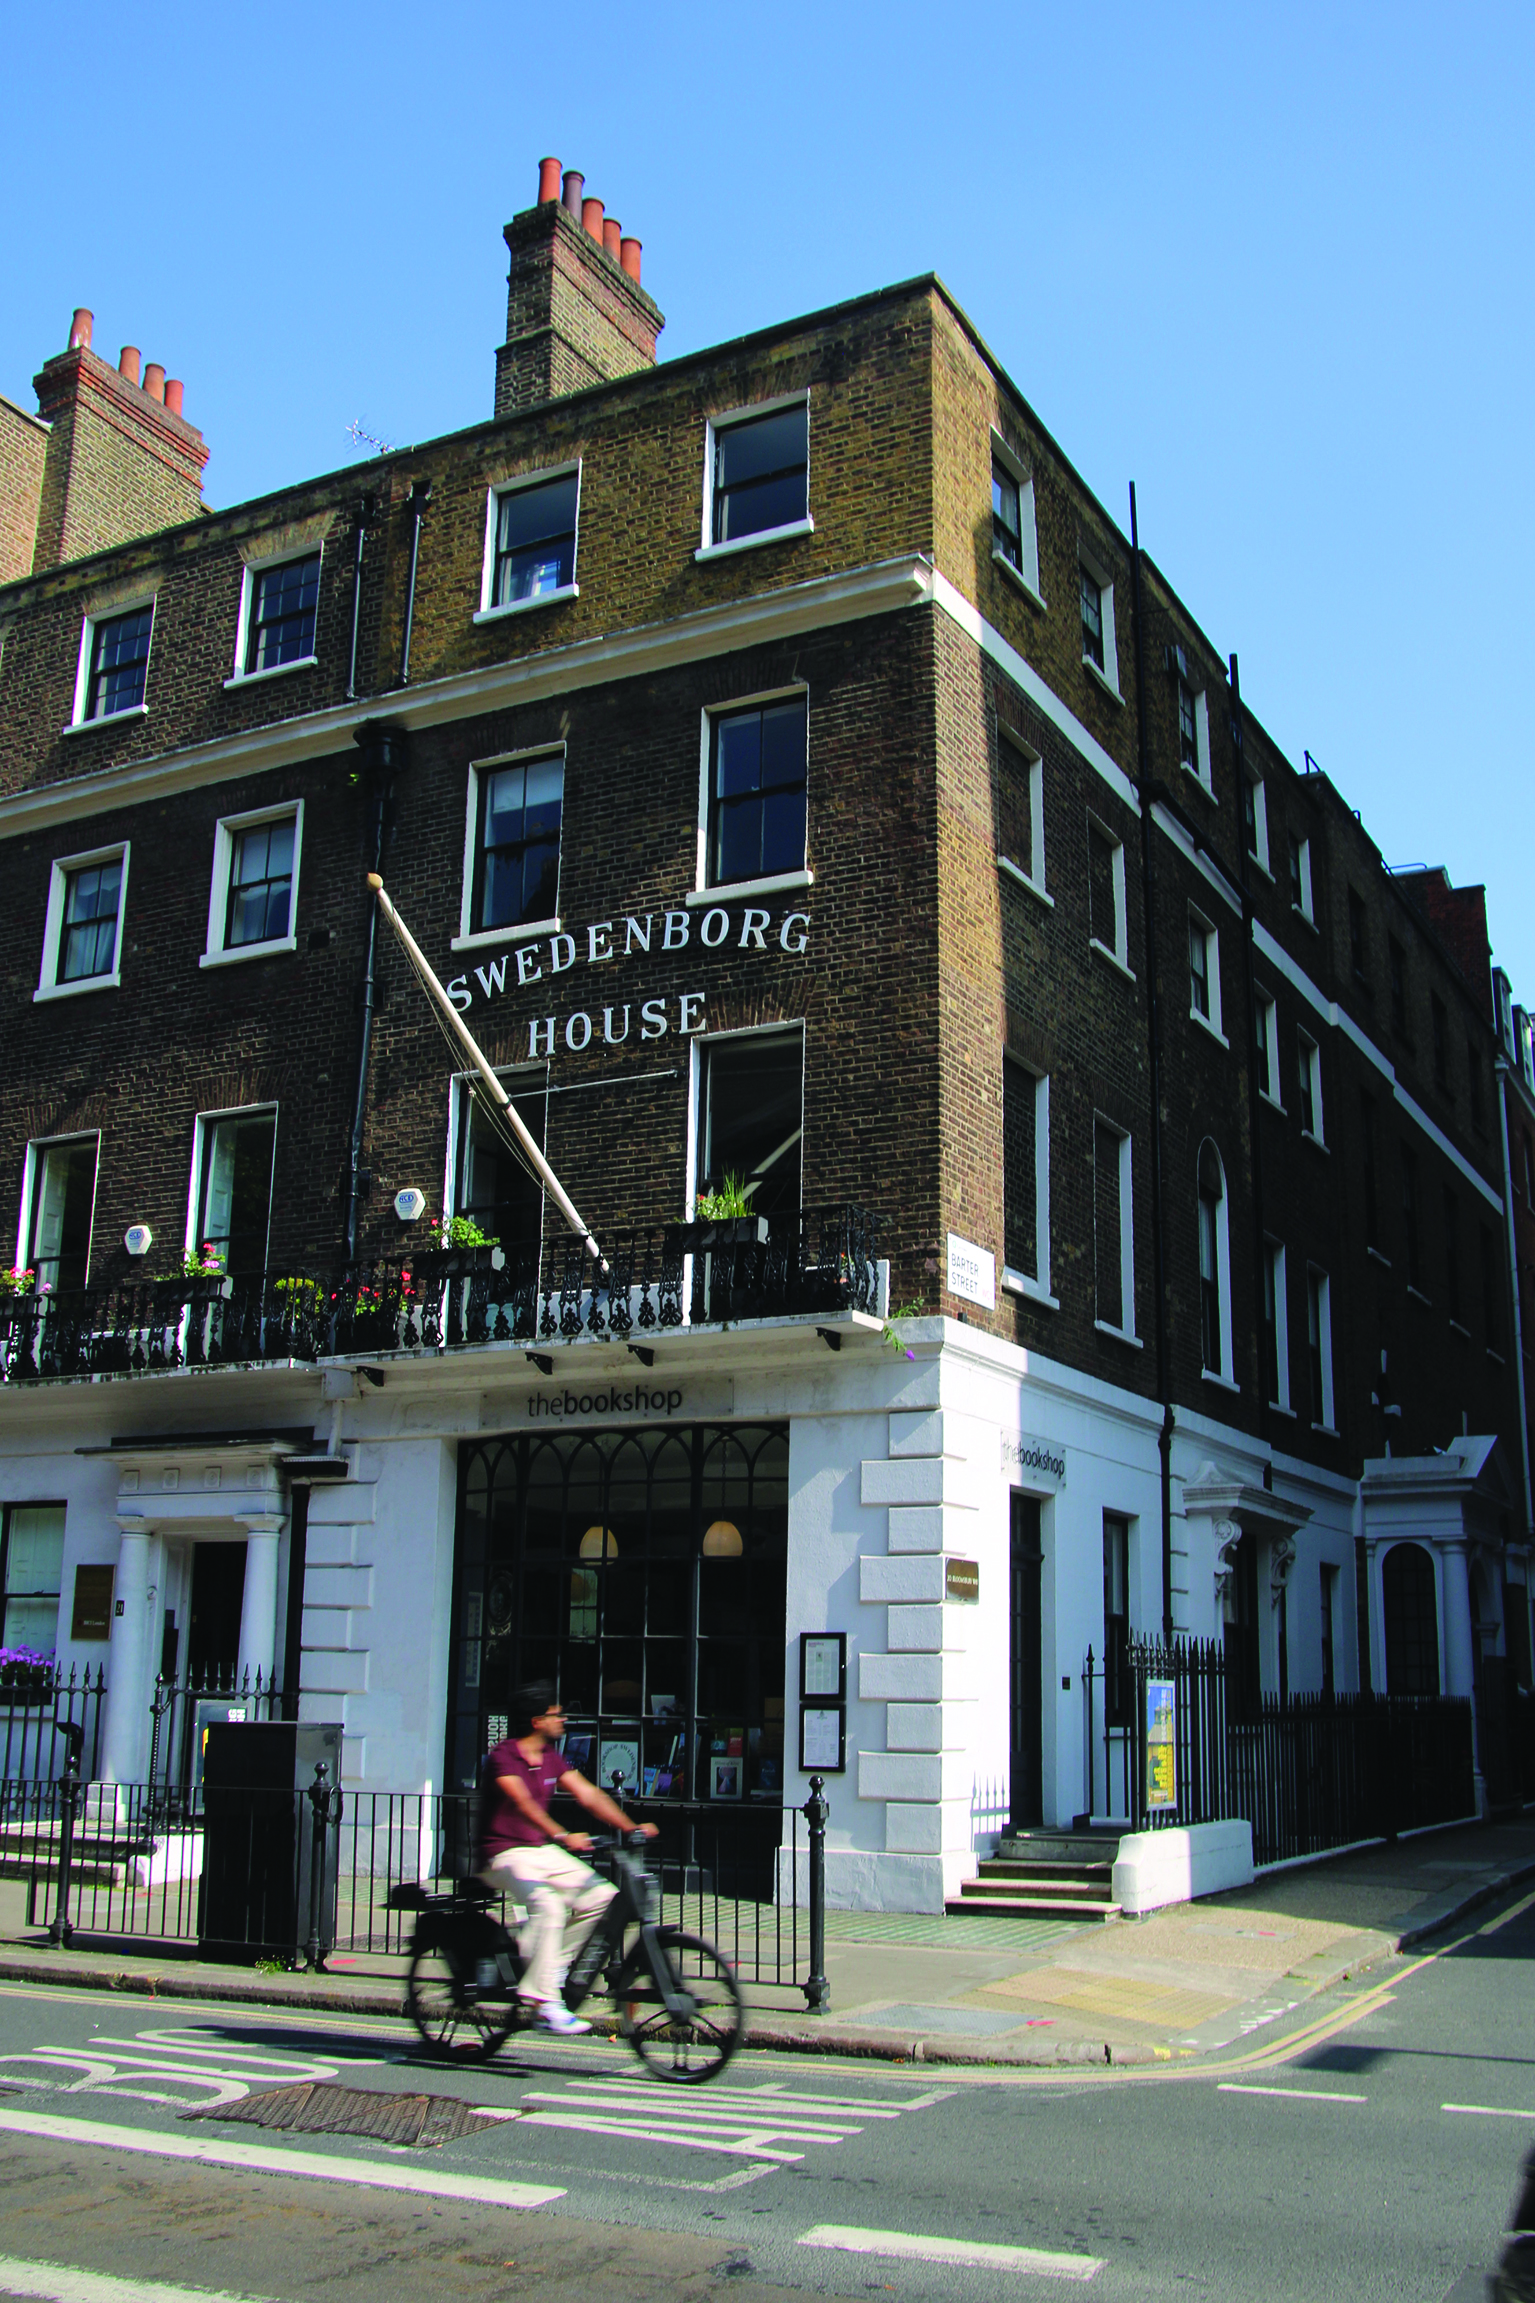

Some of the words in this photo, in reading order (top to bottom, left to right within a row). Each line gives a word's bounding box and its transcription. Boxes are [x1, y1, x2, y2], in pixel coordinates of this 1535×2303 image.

[446, 908, 811, 1012] SWEDENBORG
[528, 992, 707, 1058] HOUSE
[951, 1252, 979, 1277] BARTER
[951, 1271, 978, 1294] STREET
[527, 1385, 683, 1417] thebookshop
[1001, 1438, 1065, 1480] thebookshop
[116, 1603, 124, 1614] 21
